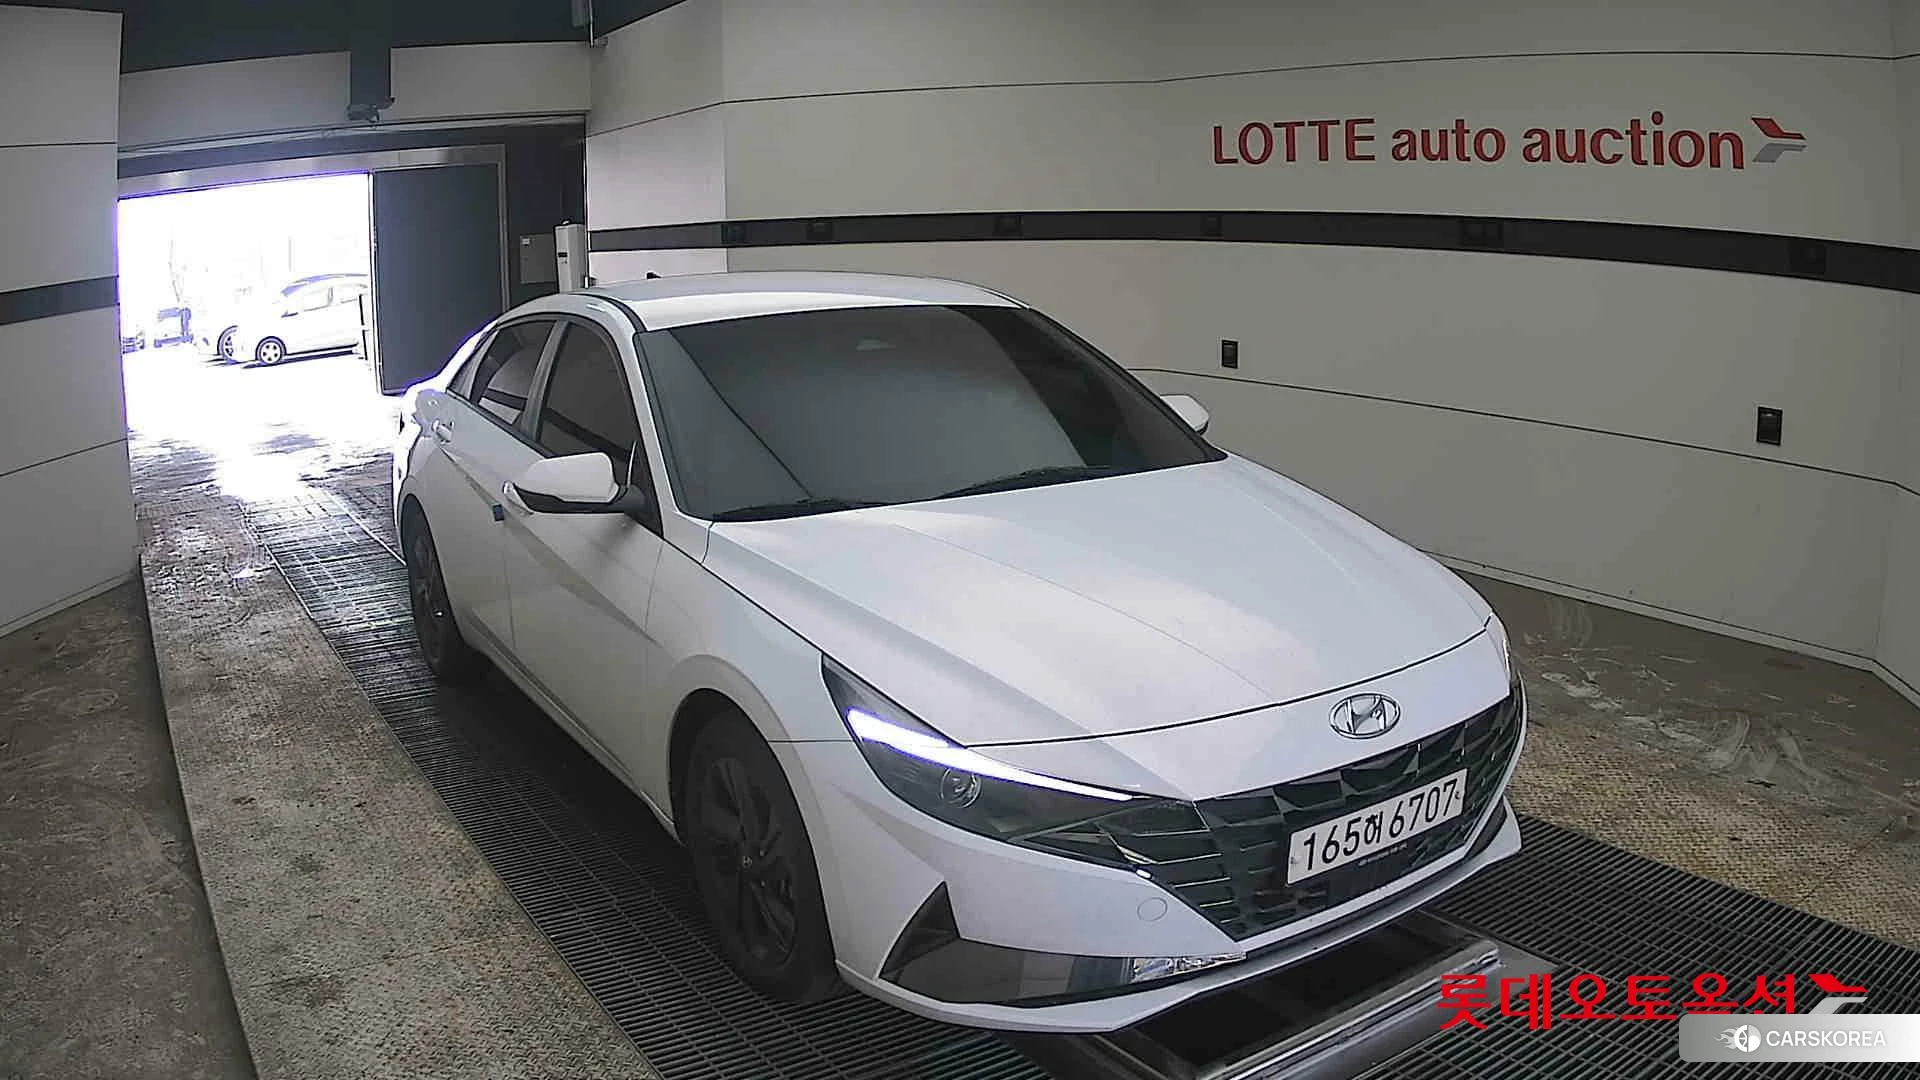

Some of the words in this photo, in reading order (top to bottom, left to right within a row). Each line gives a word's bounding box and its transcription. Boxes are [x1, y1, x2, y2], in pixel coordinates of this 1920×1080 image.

[1212, 117, 1376, 165] LOTTE
[1391, 118, 1506, 162] auto
[1522, 111, 1745, 170] auction
